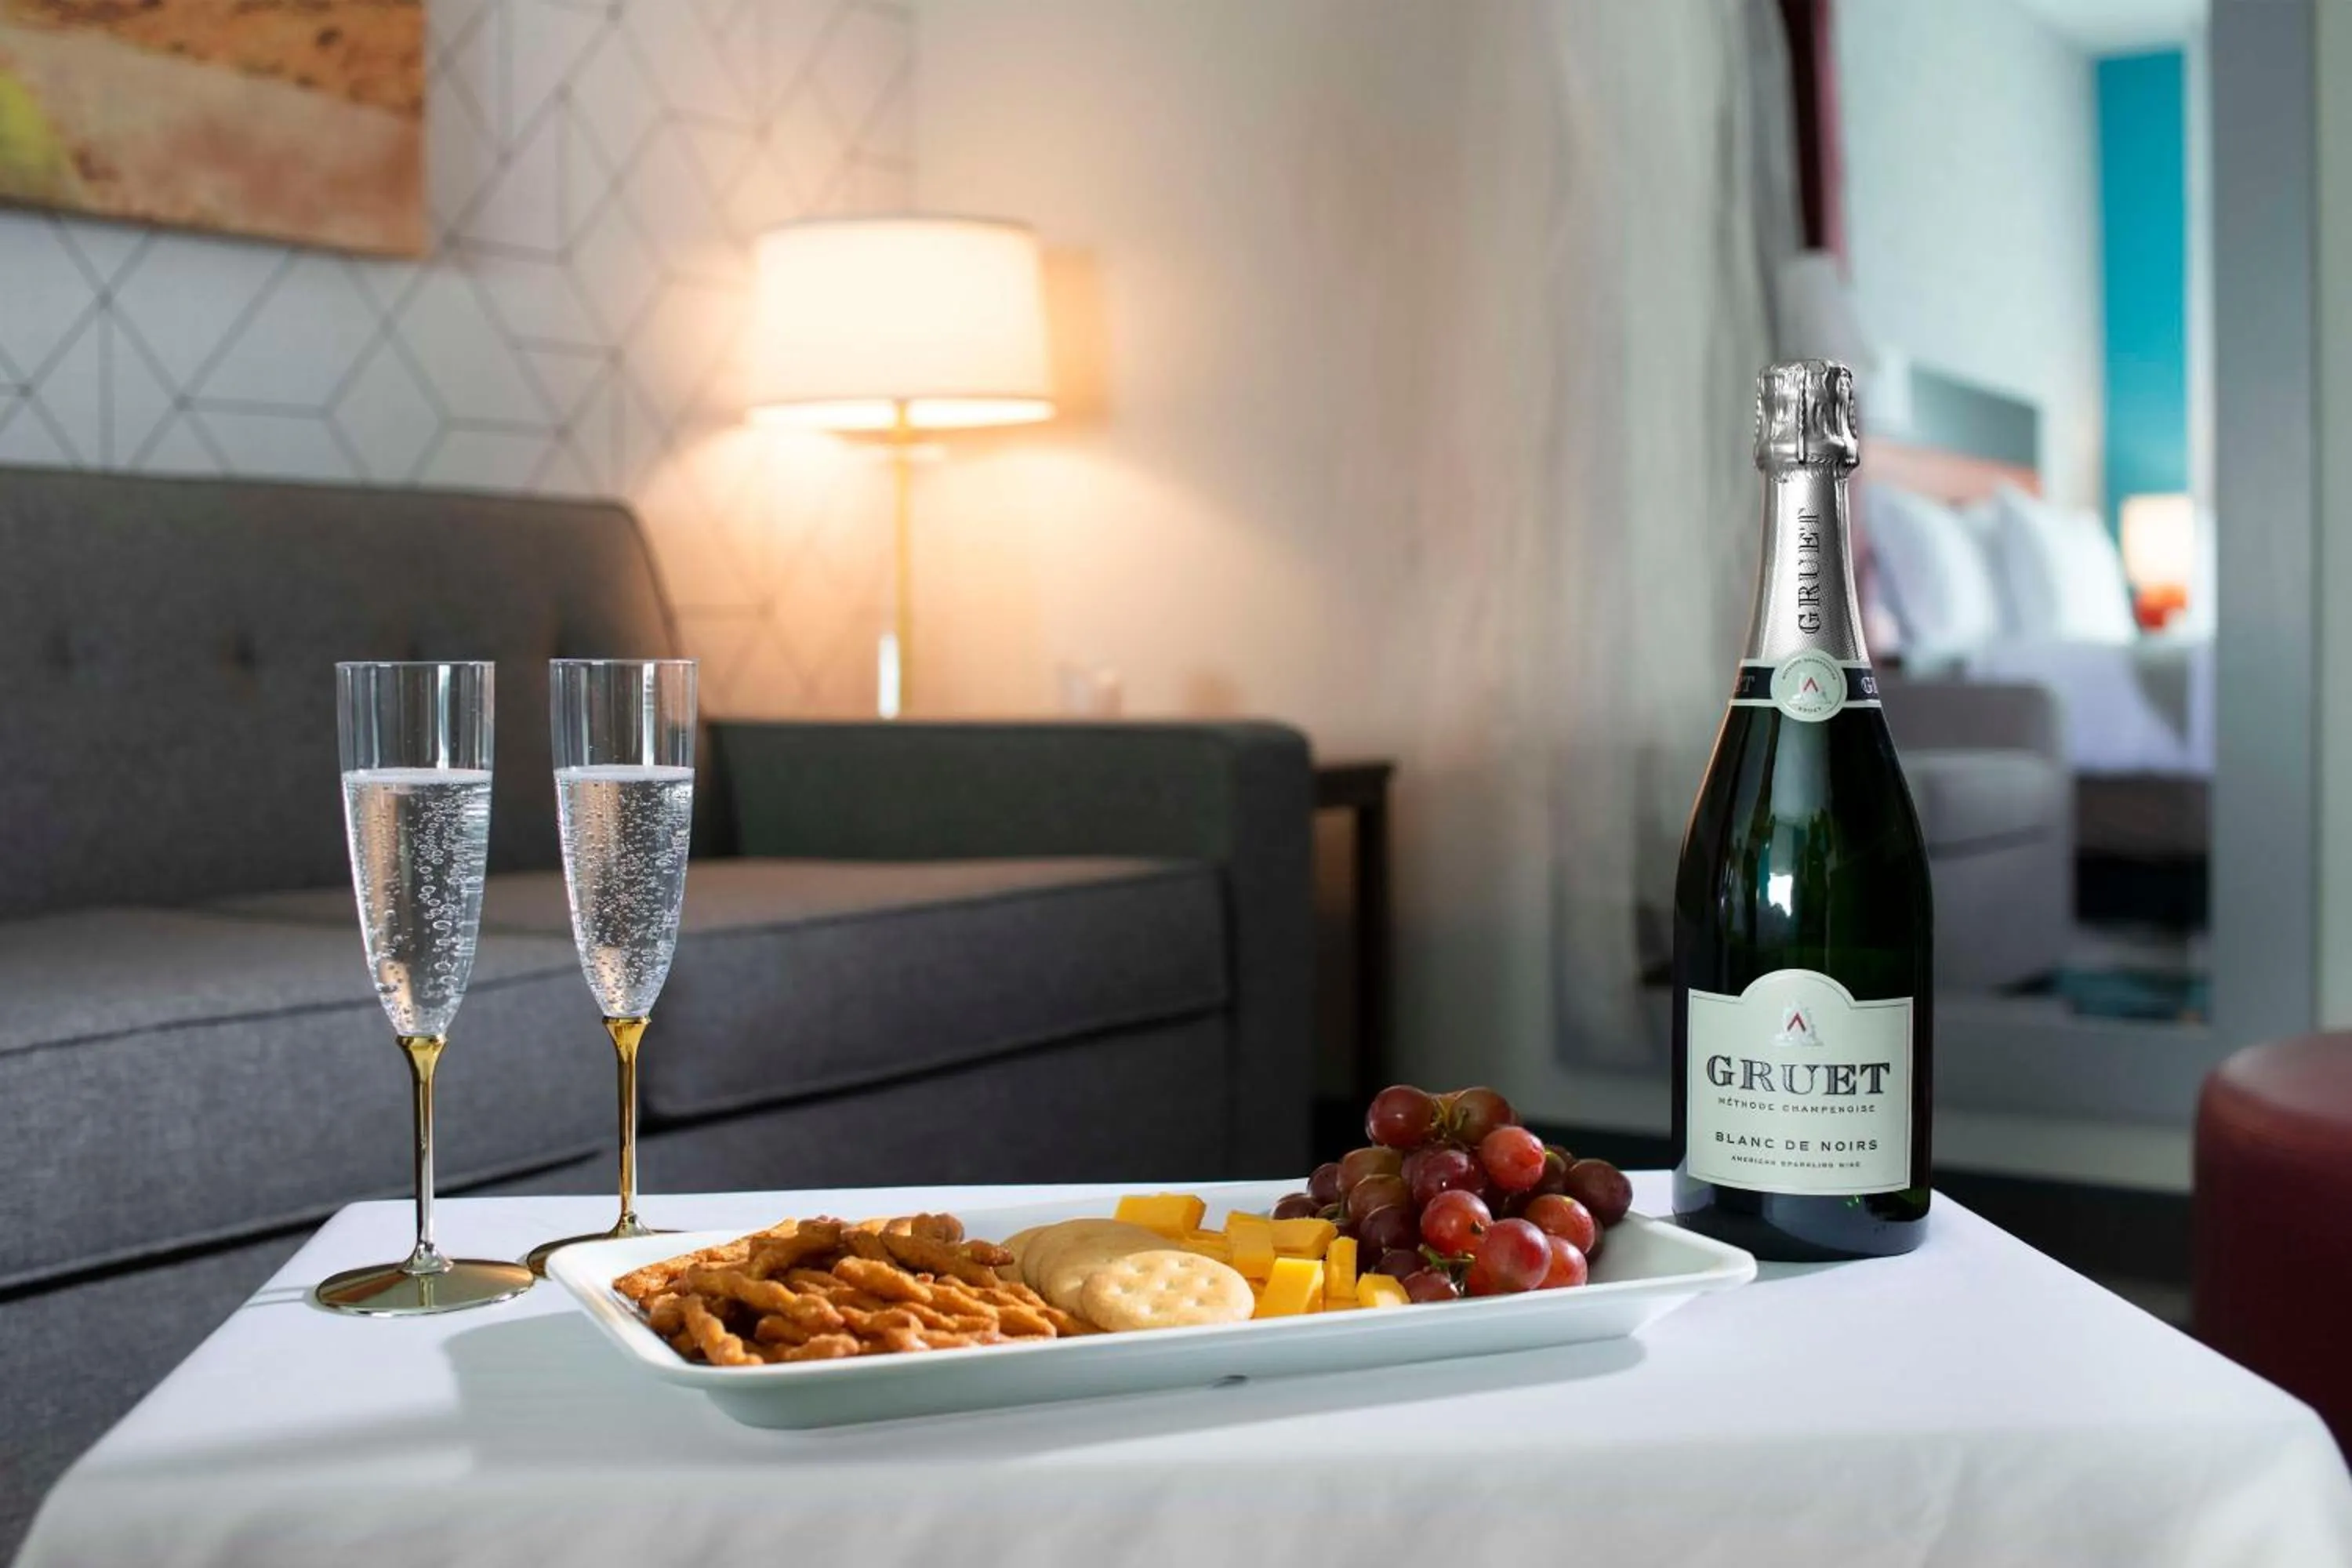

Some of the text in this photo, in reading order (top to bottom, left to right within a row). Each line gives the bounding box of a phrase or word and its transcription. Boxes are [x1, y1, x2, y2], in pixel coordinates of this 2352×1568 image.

[1798, 507, 1821, 634] GRUET
[1706, 1054, 1890, 1096] GRUET
[1715, 1131, 1878, 1152] BLANC DE NOIRS
